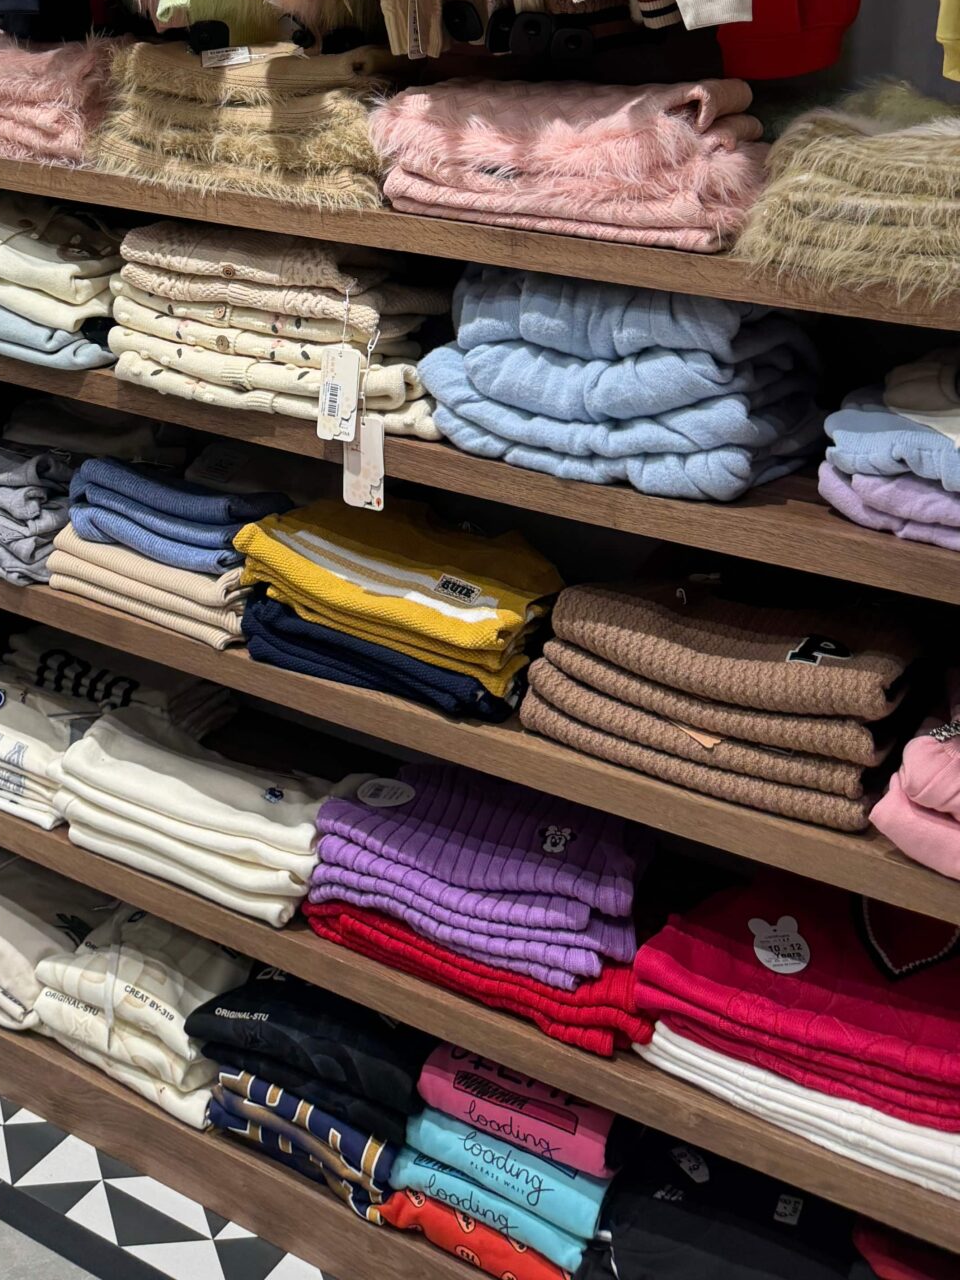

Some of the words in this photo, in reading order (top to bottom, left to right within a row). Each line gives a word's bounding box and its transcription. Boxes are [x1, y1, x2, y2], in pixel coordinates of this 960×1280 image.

[786, 634, 854, 666] P
[45, 991, 99, 1017] ORIGINAL-STU
[124, 985, 149, 1004] CREAT
[149, 999, 175, 1021] BY-319
[214, 1007, 269, 1021] ORIGINAL-STU
[464, 1100, 562, 1160] loading
[458, 1131, 554, 1206] loading
[470, 1161, 499, 1183] PLEASE
[503, 1181, 526, 1195] WAIT
[425, 1174, 519, 1235] loading
